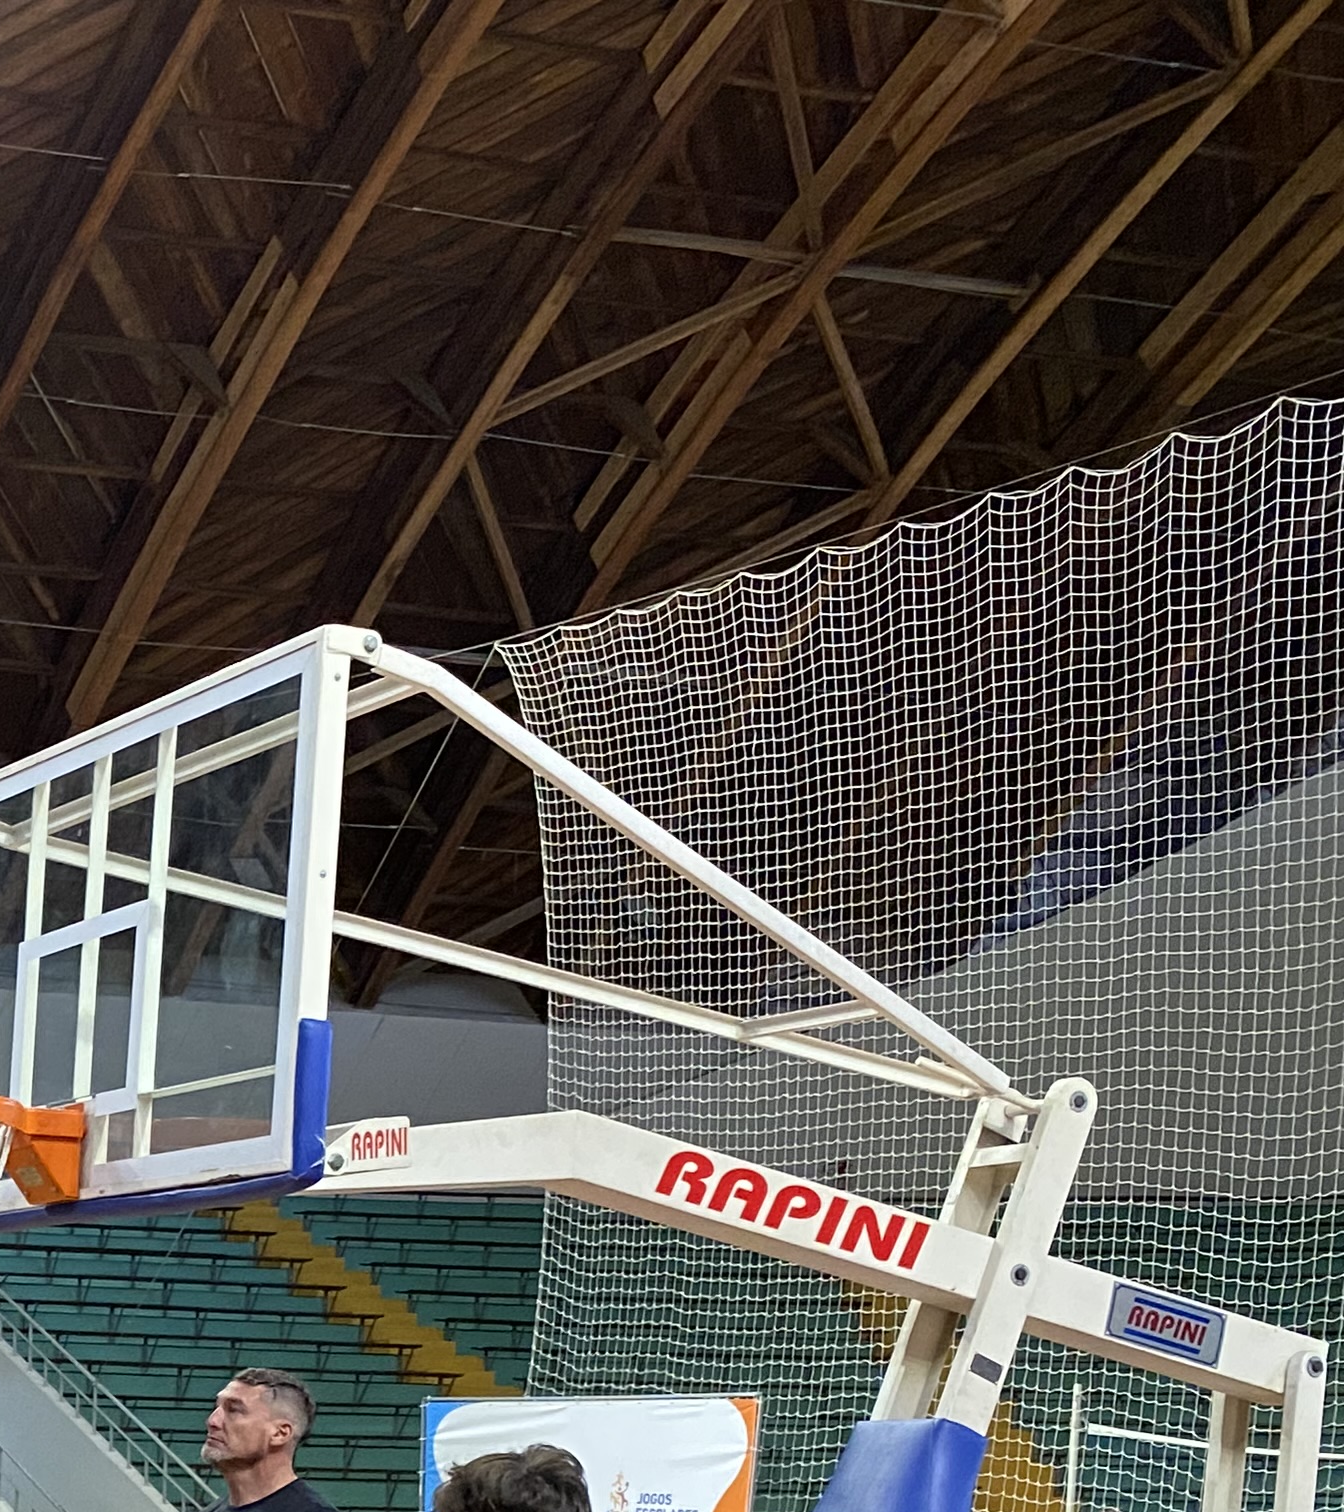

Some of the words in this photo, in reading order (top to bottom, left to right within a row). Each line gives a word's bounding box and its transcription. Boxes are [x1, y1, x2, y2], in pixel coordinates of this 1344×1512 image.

[351, 1126, 408, 1161] RAPINI
[655, 1151, 930, 1270] RAPINI
[1127, 1305, 1207, 1346] RAPINI
[636, 1493, 673, 1506] JOGOS
